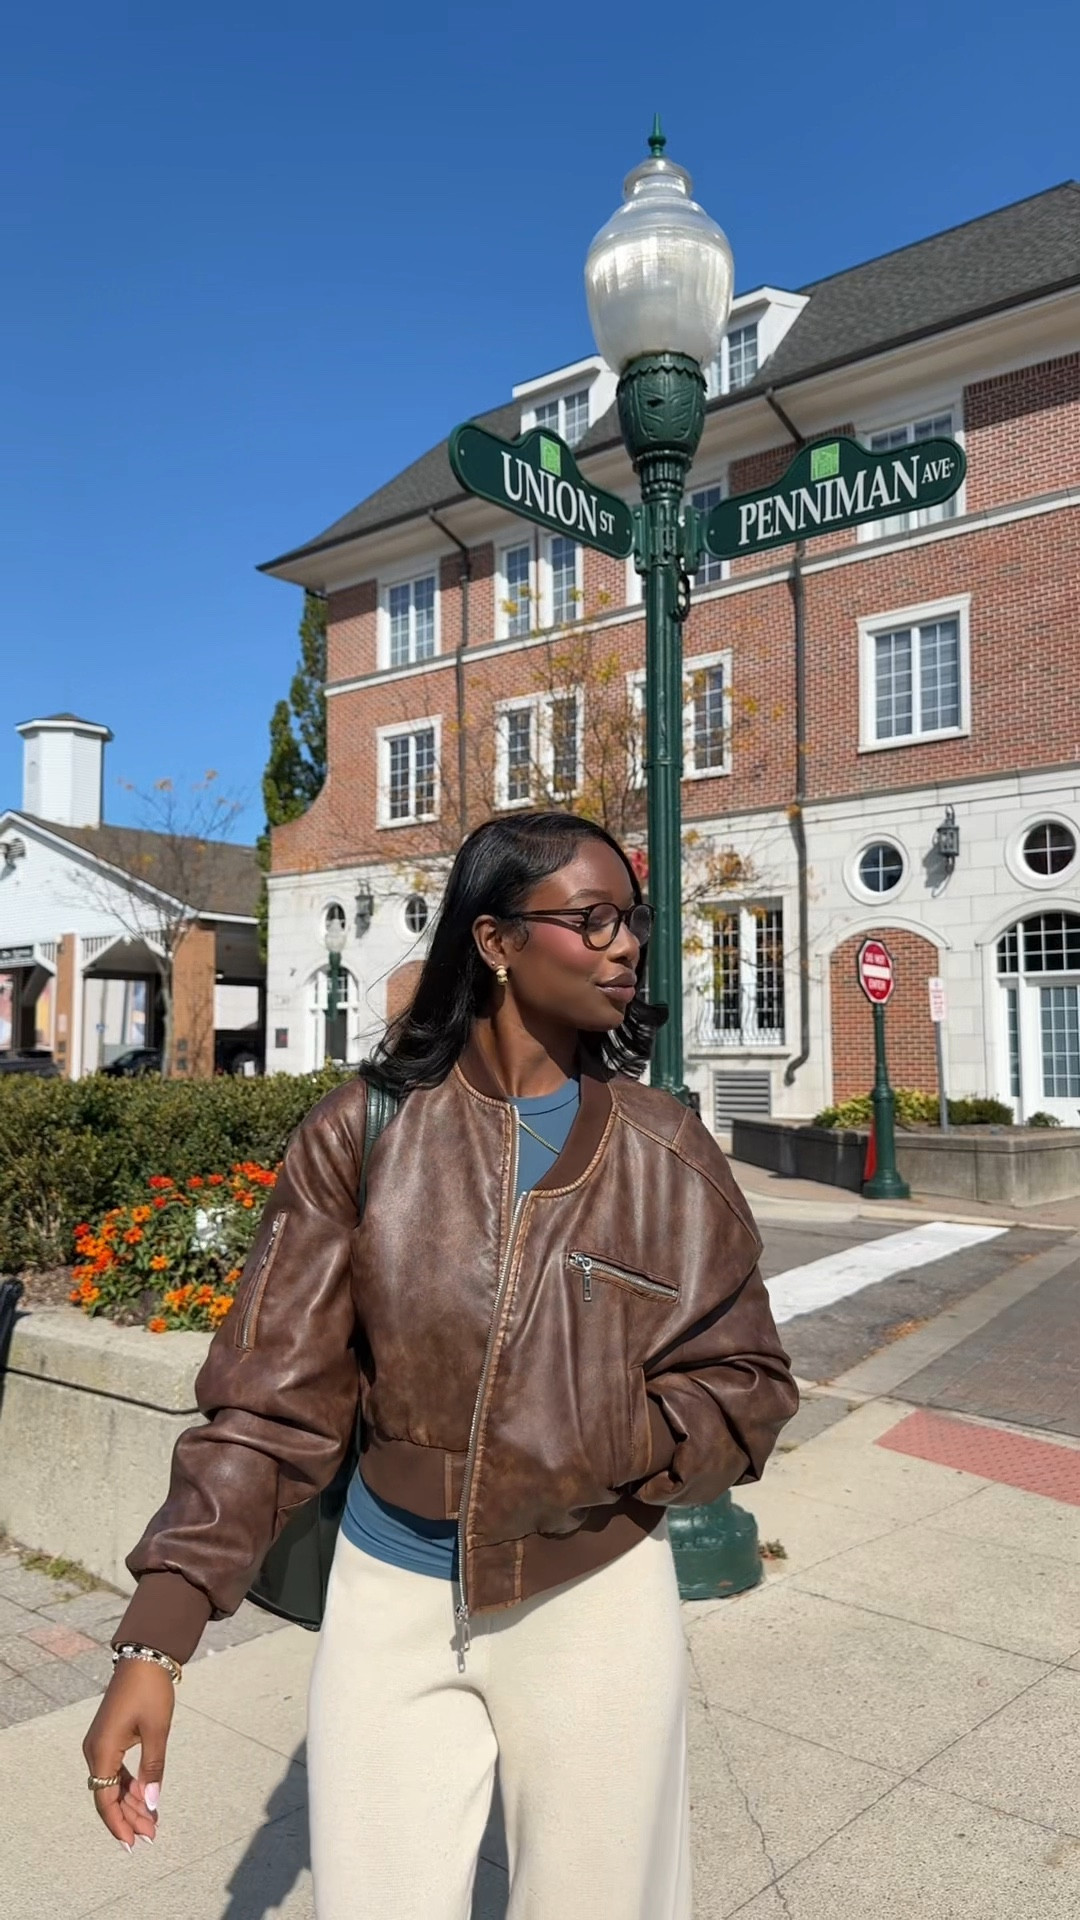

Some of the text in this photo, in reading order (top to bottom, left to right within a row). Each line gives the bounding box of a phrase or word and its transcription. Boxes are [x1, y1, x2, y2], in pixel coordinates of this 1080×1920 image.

[501, 450, 616, 537] UNION ST
[738, 455, 920, 545] PENNIMAN
[865, 951, 887, 966] DO NOT
[867, 977, 887, 992] ENTER
